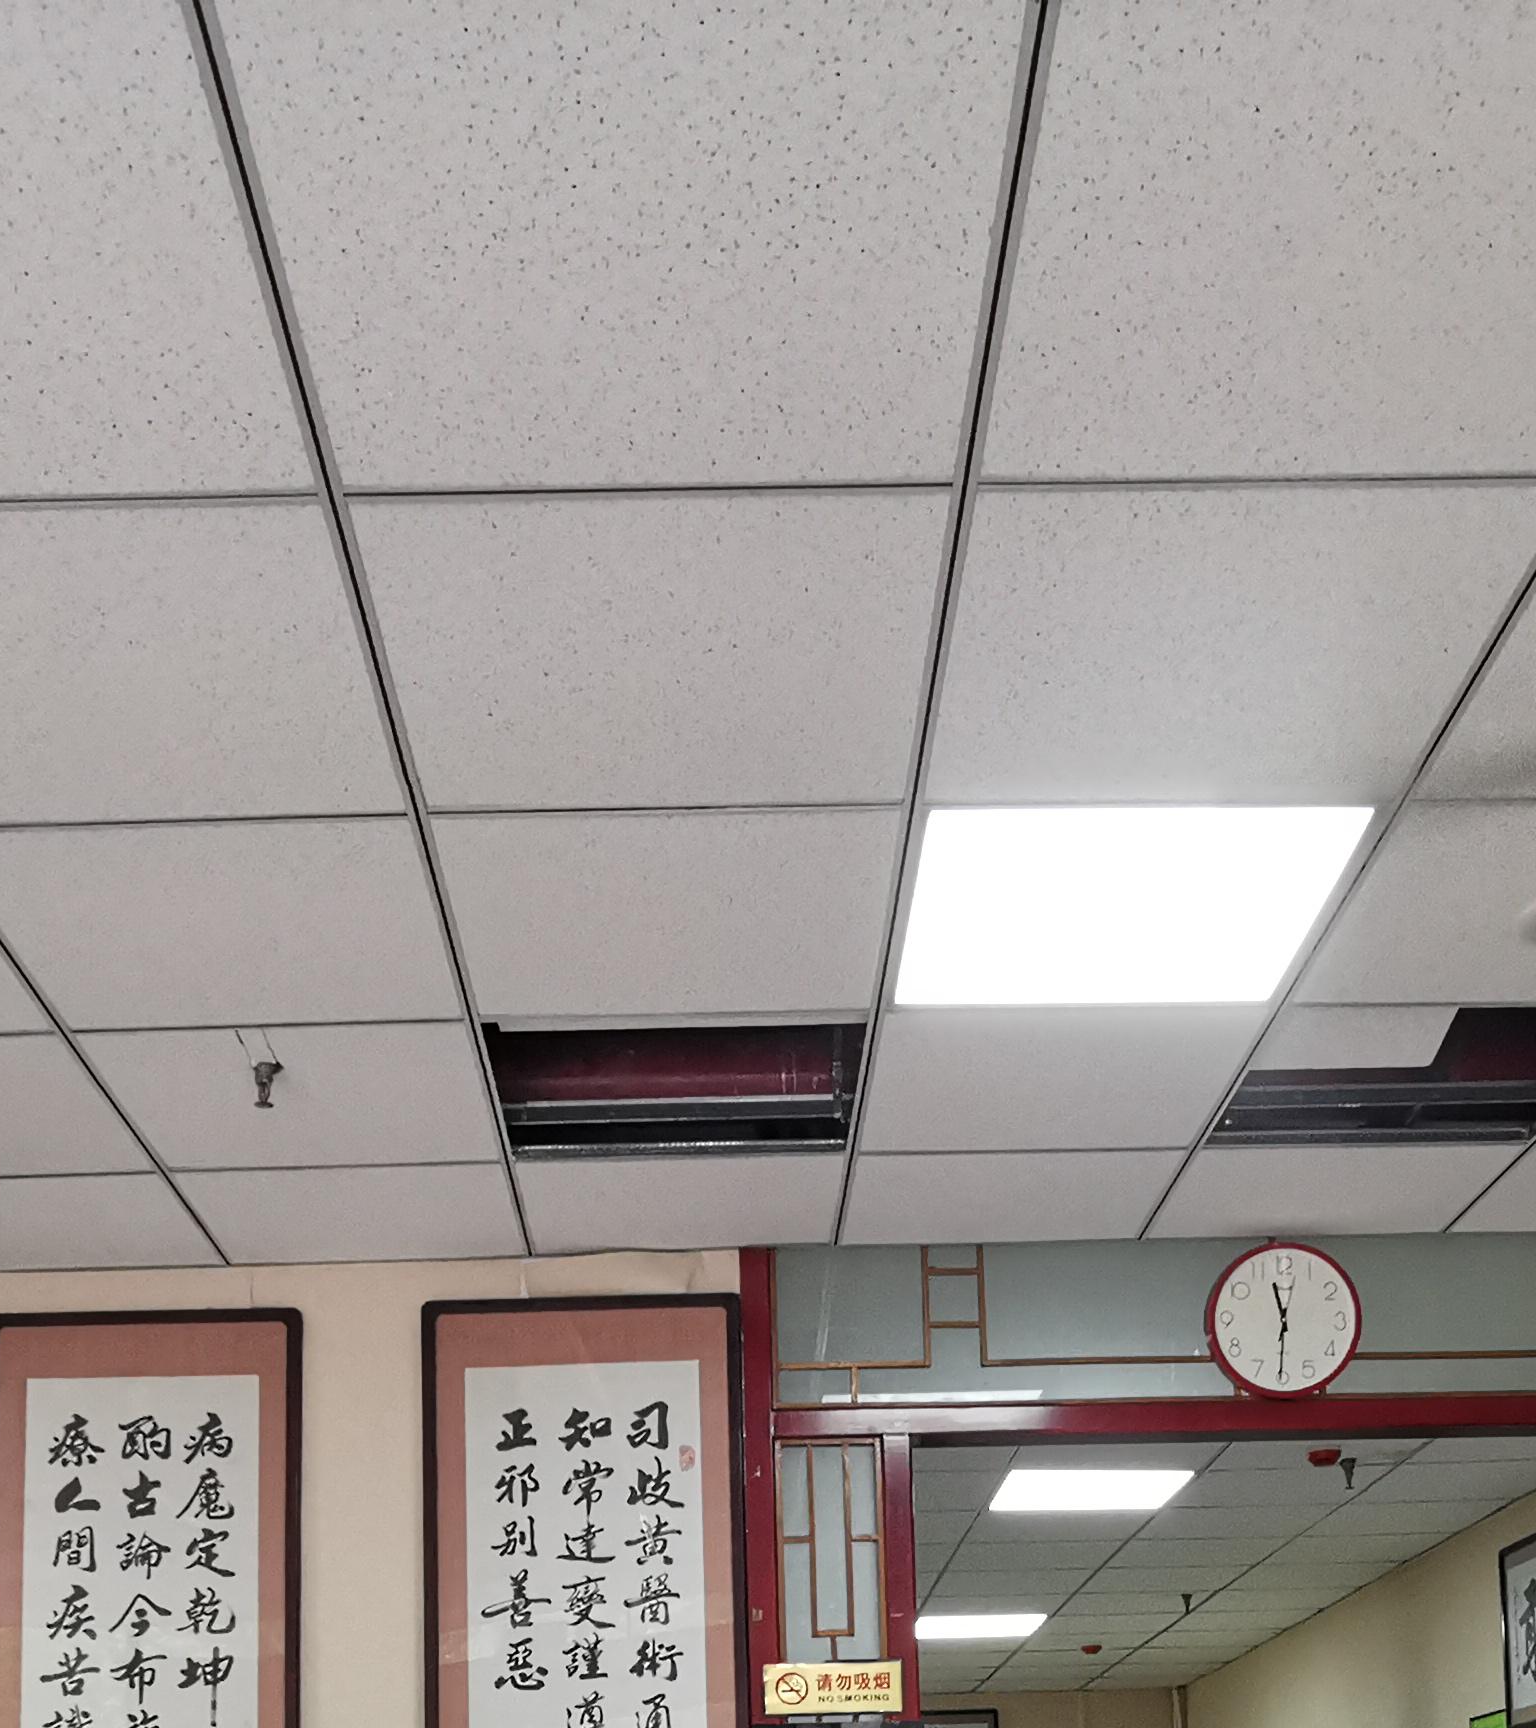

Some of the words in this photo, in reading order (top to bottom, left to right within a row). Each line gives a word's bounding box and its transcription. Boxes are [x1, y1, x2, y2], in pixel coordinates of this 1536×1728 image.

[1250, 1262, 1264, 1280] 11
[1276, 1256, 1293, 1275] 12
[1306, 1261, 1312, 1281] 1
[1231, 1282, 1251, 1301] 10
[1323, 1281, 1338, 1301] 2
[1220, 1314, 1234, 1329] 9
[1333, 1311, 1348, 1331] 3
[1228, 1337, 1241, 1358] 8
[1324, 1340, 1336, 1356] 4
[1252, 1359, 1264, 1378] 7
[1301, 1360, 1316, 1379] 5
[177, 1413, 235, 1726] 病魔定乾坤
[816, 1672, 891, 1692] 请勿吸烟
